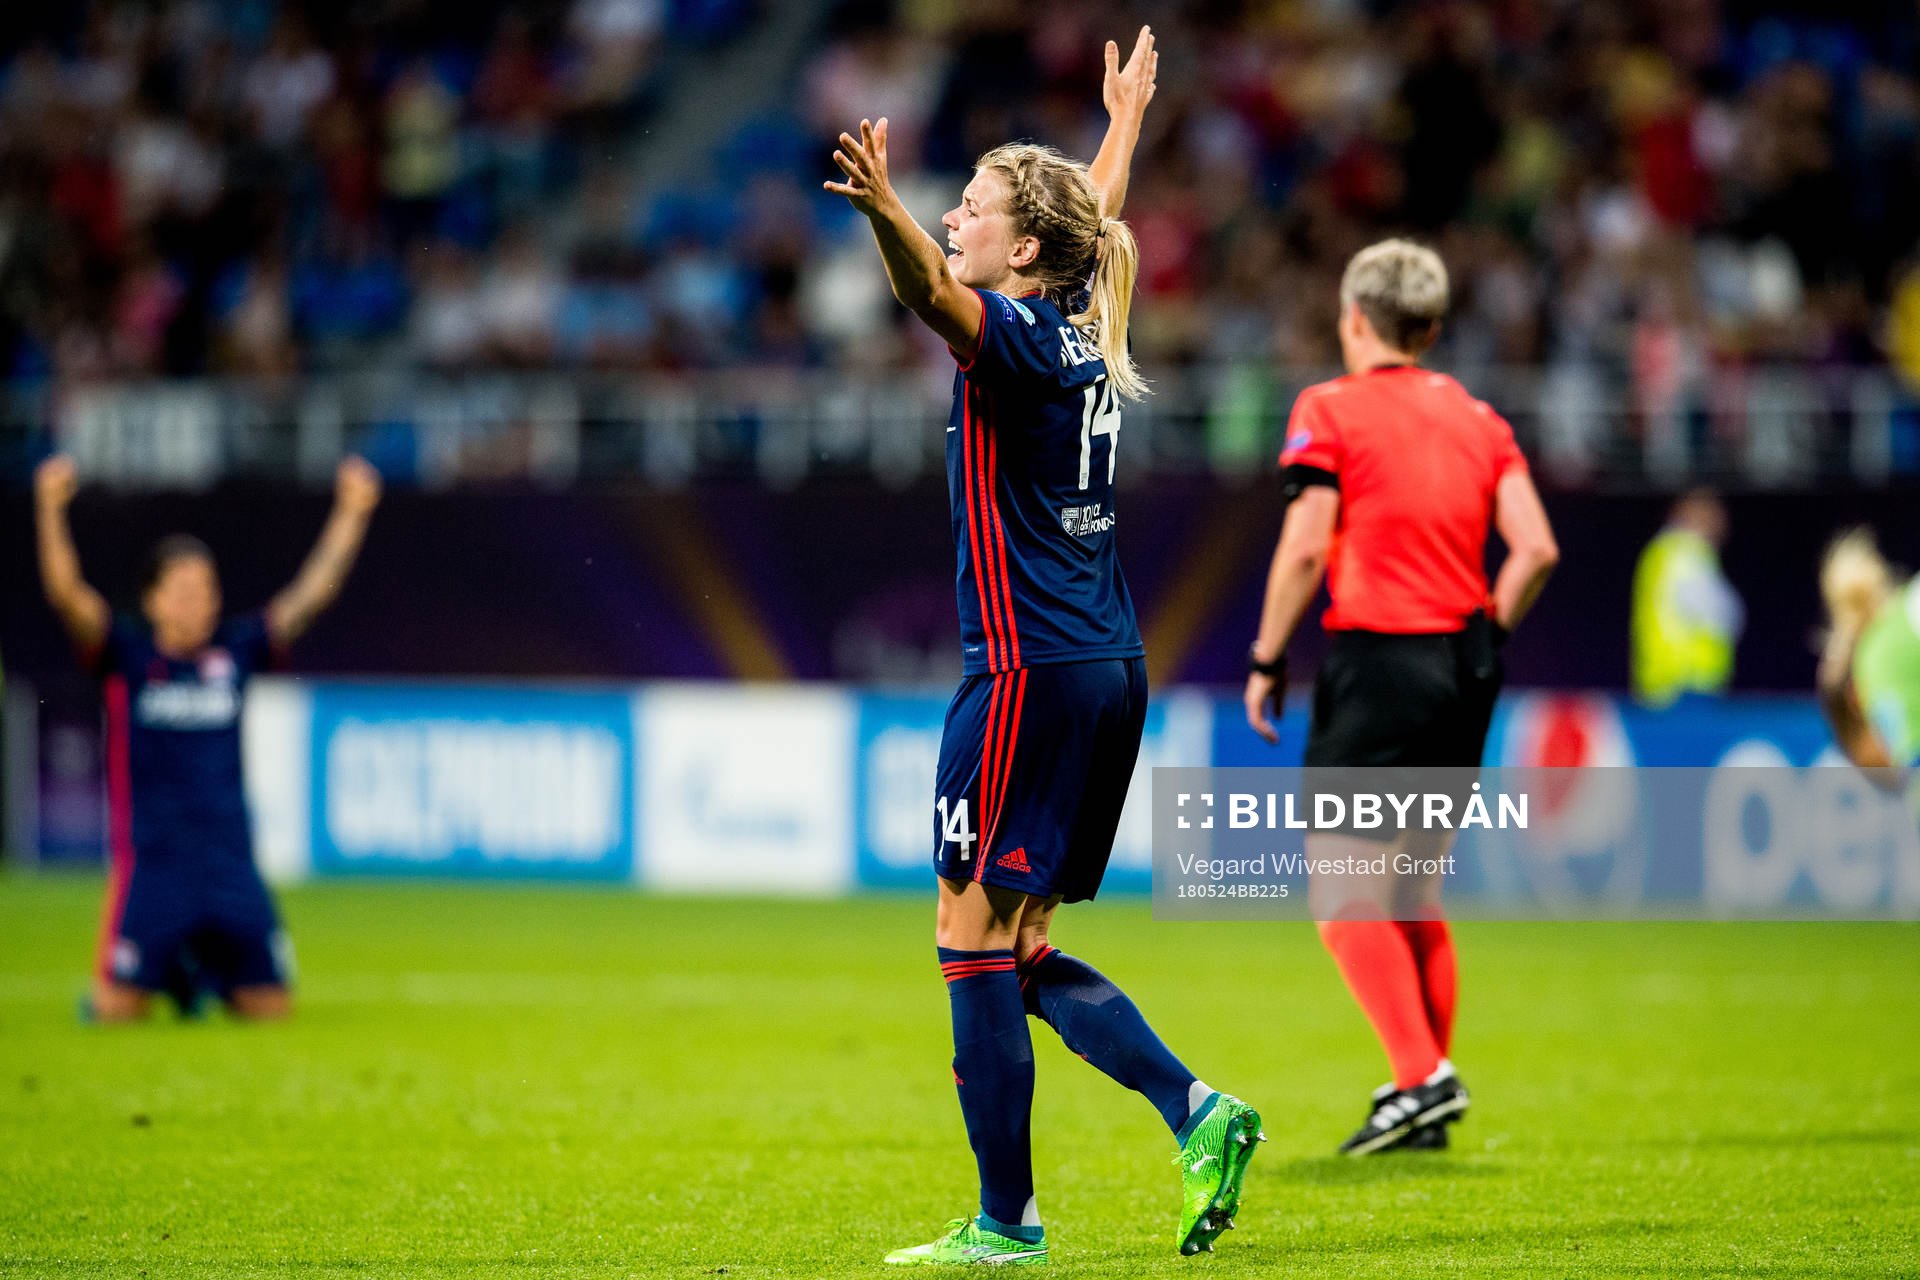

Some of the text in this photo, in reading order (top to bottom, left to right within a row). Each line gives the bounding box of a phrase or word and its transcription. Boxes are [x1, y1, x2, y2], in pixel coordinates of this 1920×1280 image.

[1079, 374, 1121, 490] 14
[936, 796, 977, 861] 14
[997, 858, 1032, 874] adidas
[1702, 735, 1920, 918] pe
